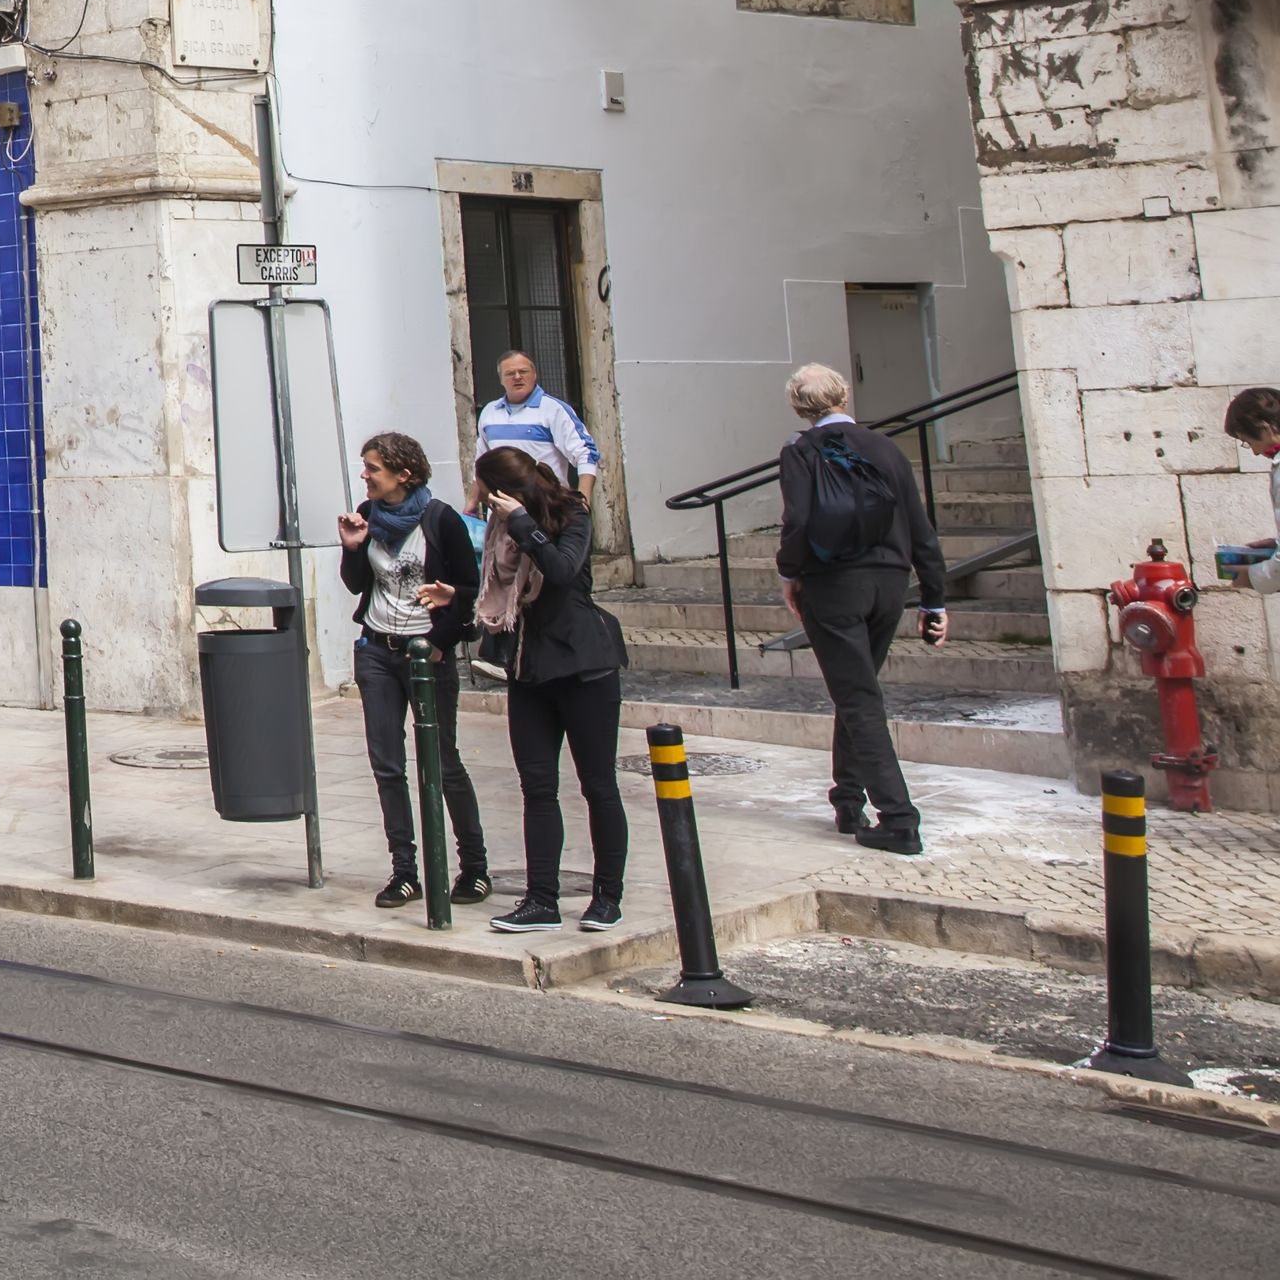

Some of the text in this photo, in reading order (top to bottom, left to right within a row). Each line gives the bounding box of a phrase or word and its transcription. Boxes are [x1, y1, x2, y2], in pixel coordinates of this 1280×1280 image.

[209, 19, 225, 33] DA
[182, 40, 252, 57] BICA GRANDE
[255, 248, 302, 263] EXCEPTO
[260, 266, 299, 281] CARRIS
